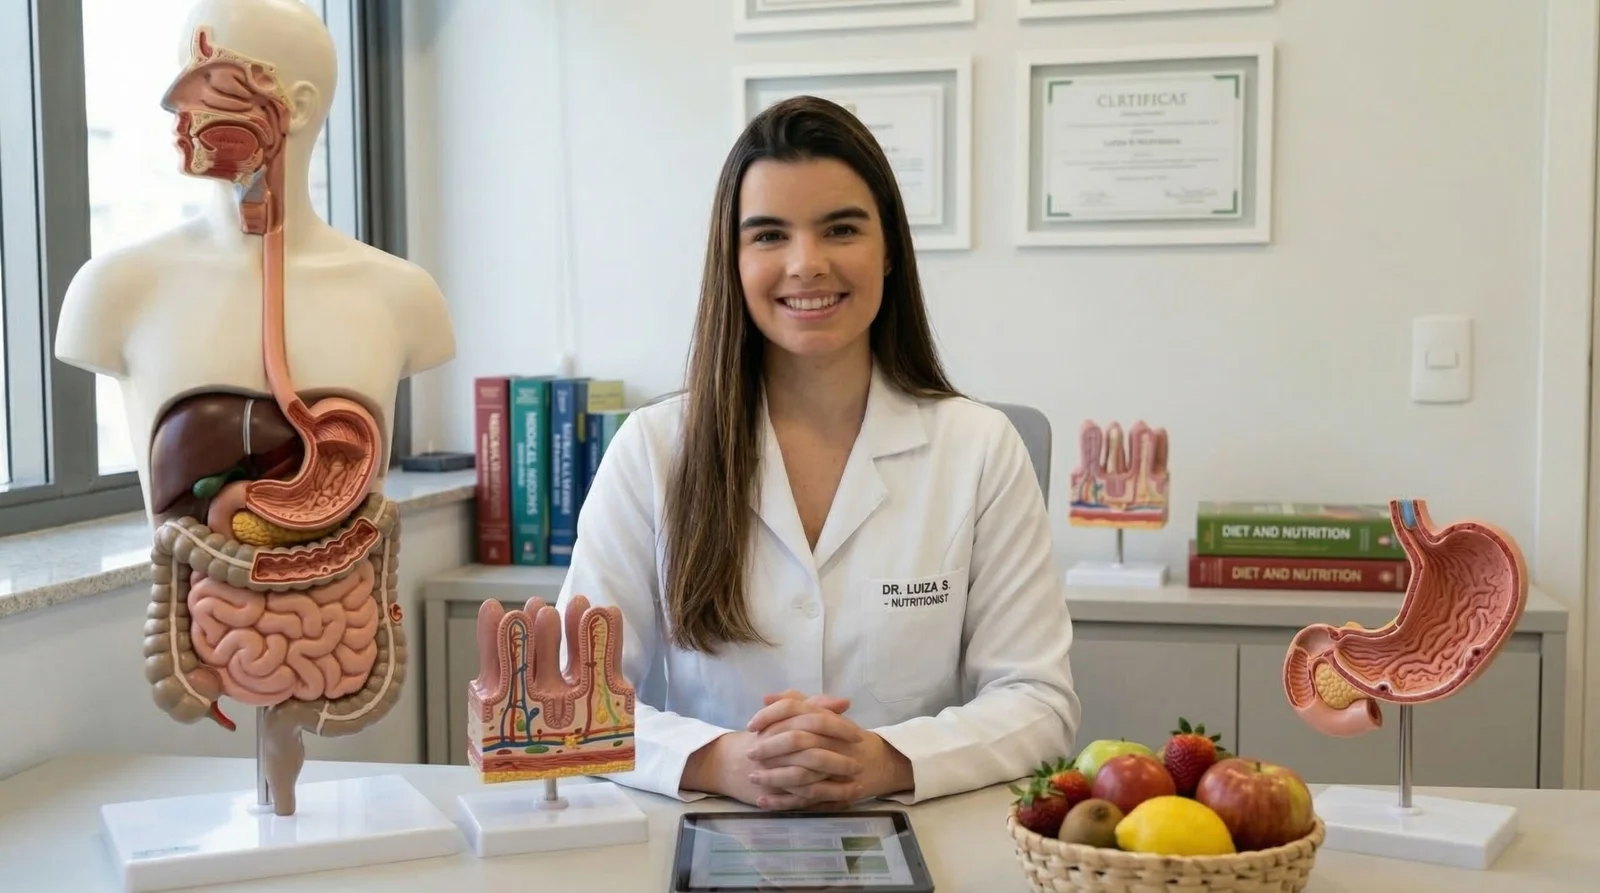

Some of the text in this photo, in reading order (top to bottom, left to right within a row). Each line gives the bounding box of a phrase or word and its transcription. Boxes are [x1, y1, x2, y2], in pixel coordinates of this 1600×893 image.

[1222, 525, 1351, 540] DIET AND NUTRITION
[1232, 566, 1362, 583] DIET AND NUTRITION
[882, 584, 902, 595] DR.
[906, 581, 938, 595] LUIZA
[891, 593, 949, 608] NUTRITIONIST
